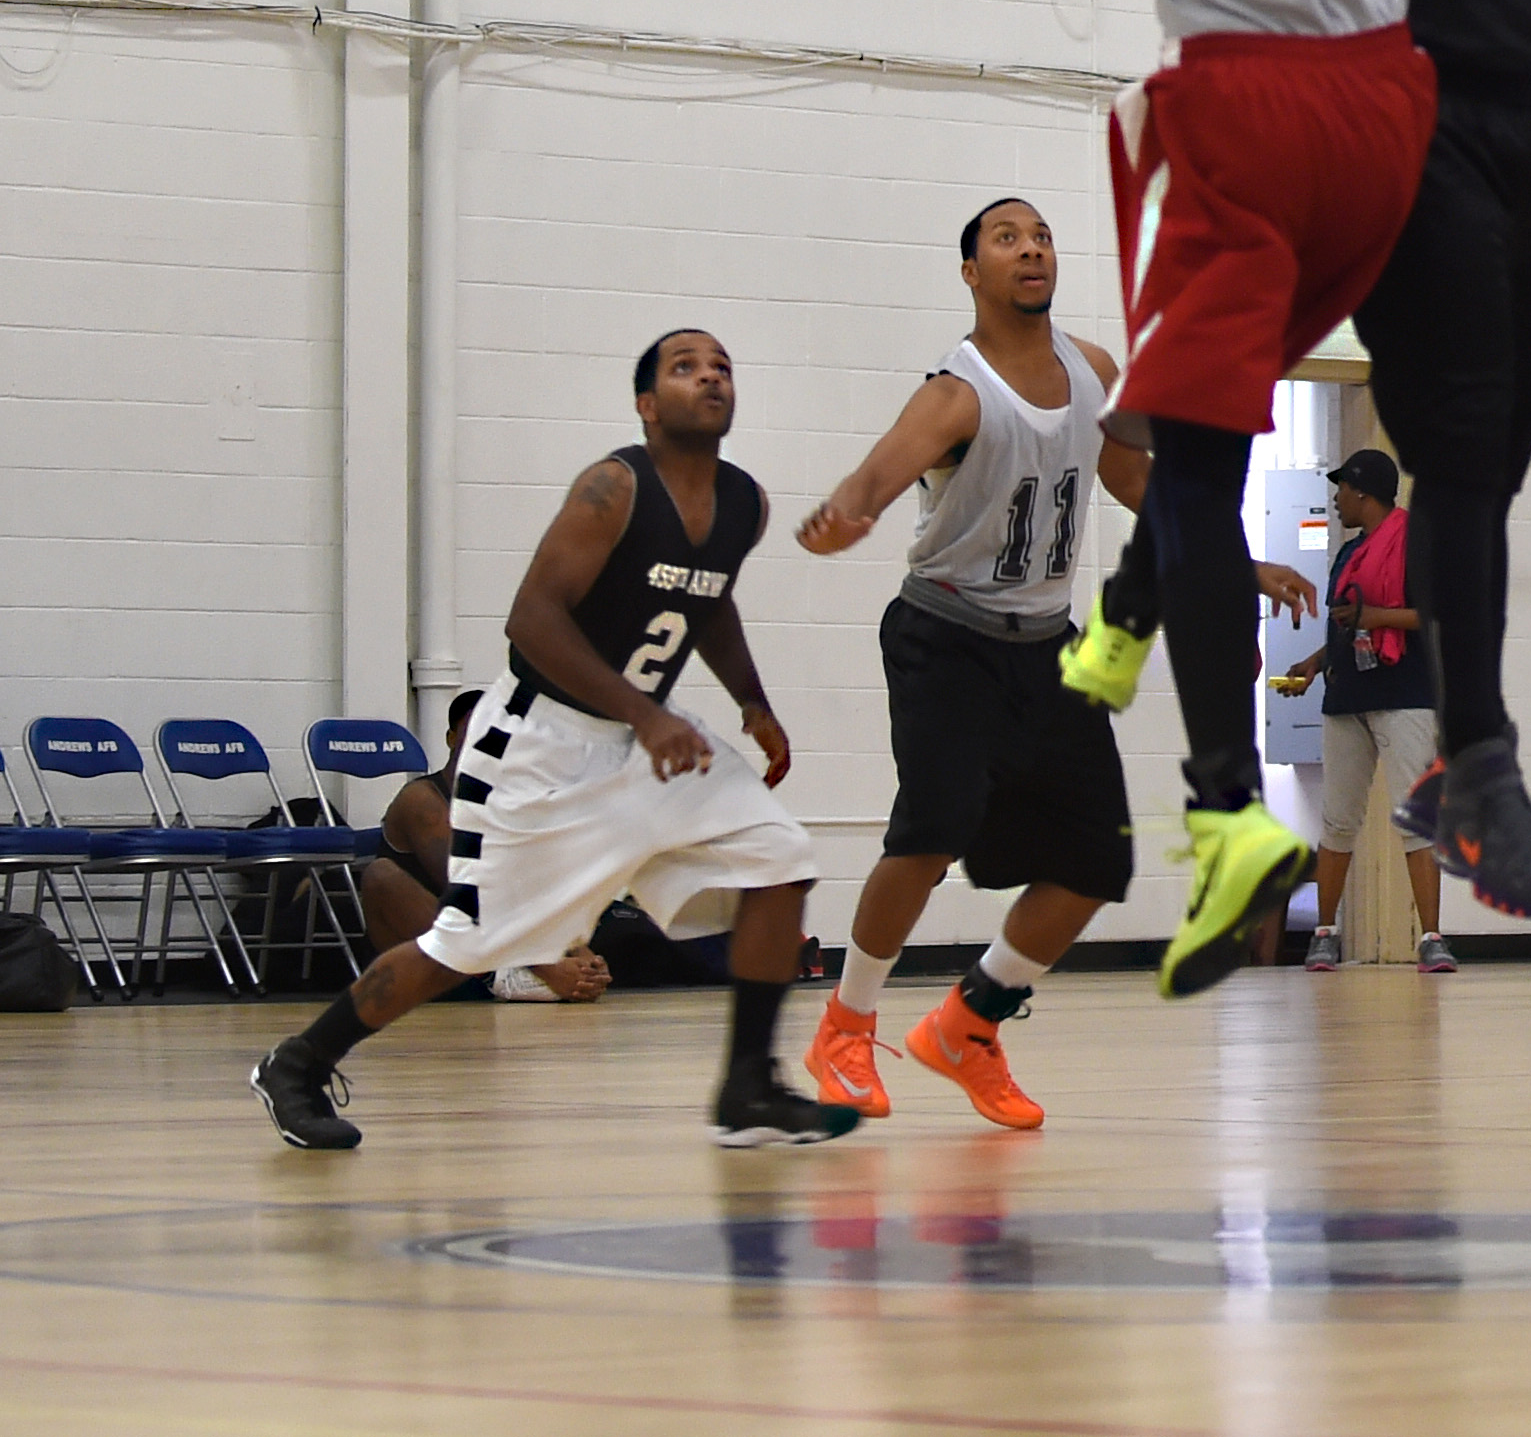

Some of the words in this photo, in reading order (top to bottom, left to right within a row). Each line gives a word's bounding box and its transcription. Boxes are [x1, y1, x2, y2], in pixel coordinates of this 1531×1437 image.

[992, 467, 1079, 583] 11
[621, 610, 688, 693] 2
[48, 740, 92, 753] ANDREWS
[97, 741, 118, 753] AFB
[177, 741, 221, 755] ANDREWS
[224, 741, 245, 754] AFB
[328, 740, 378, 753] ANDREWS
[383, 741, 405, 753] AFB
